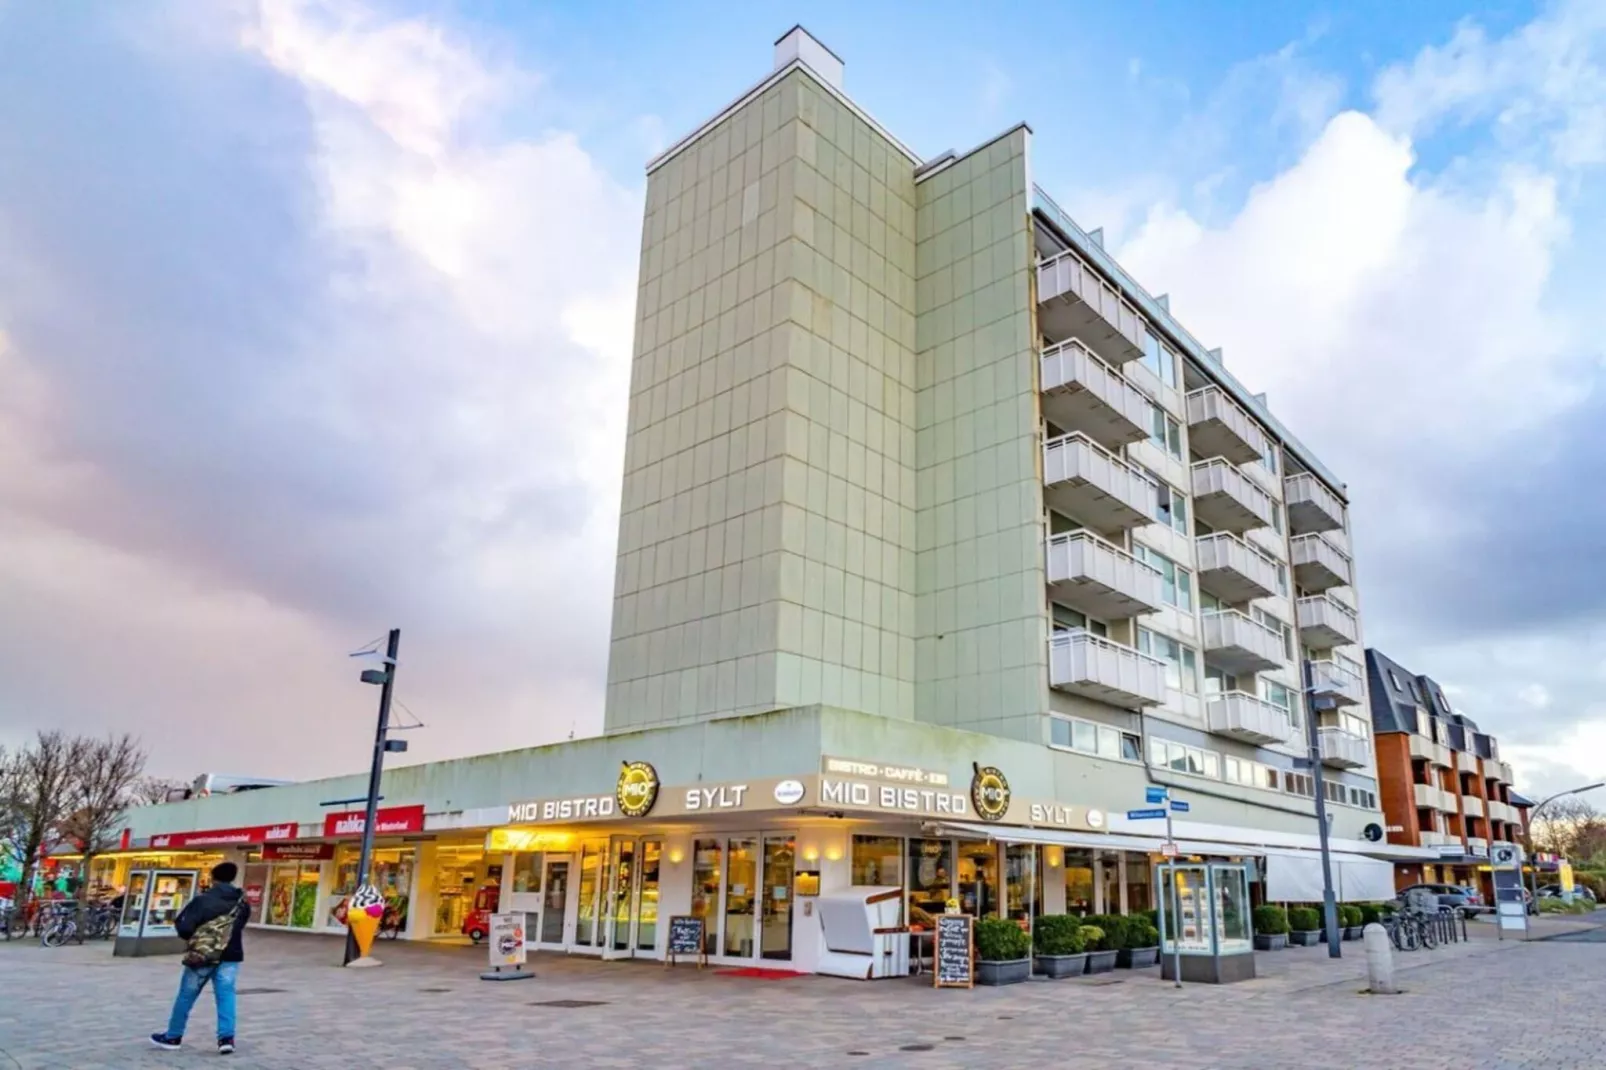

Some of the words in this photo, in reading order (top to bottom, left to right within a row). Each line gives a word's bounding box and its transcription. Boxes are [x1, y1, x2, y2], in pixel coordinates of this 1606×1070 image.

[828, 758, 877, 776] BISTRO
[624, 782, 648, 797] MIO
[685, 785, 748, 809] SYLT
[822, 779, 869, 805] MIO
[880, 786, 966, 813] BISTRO
[981, 787, 1003, 801] MIO
[508, 803, 537, 821] MIO
[543, 797, 613, 819] BISTRO
[1031, 804, 1072, 824] SYLT
